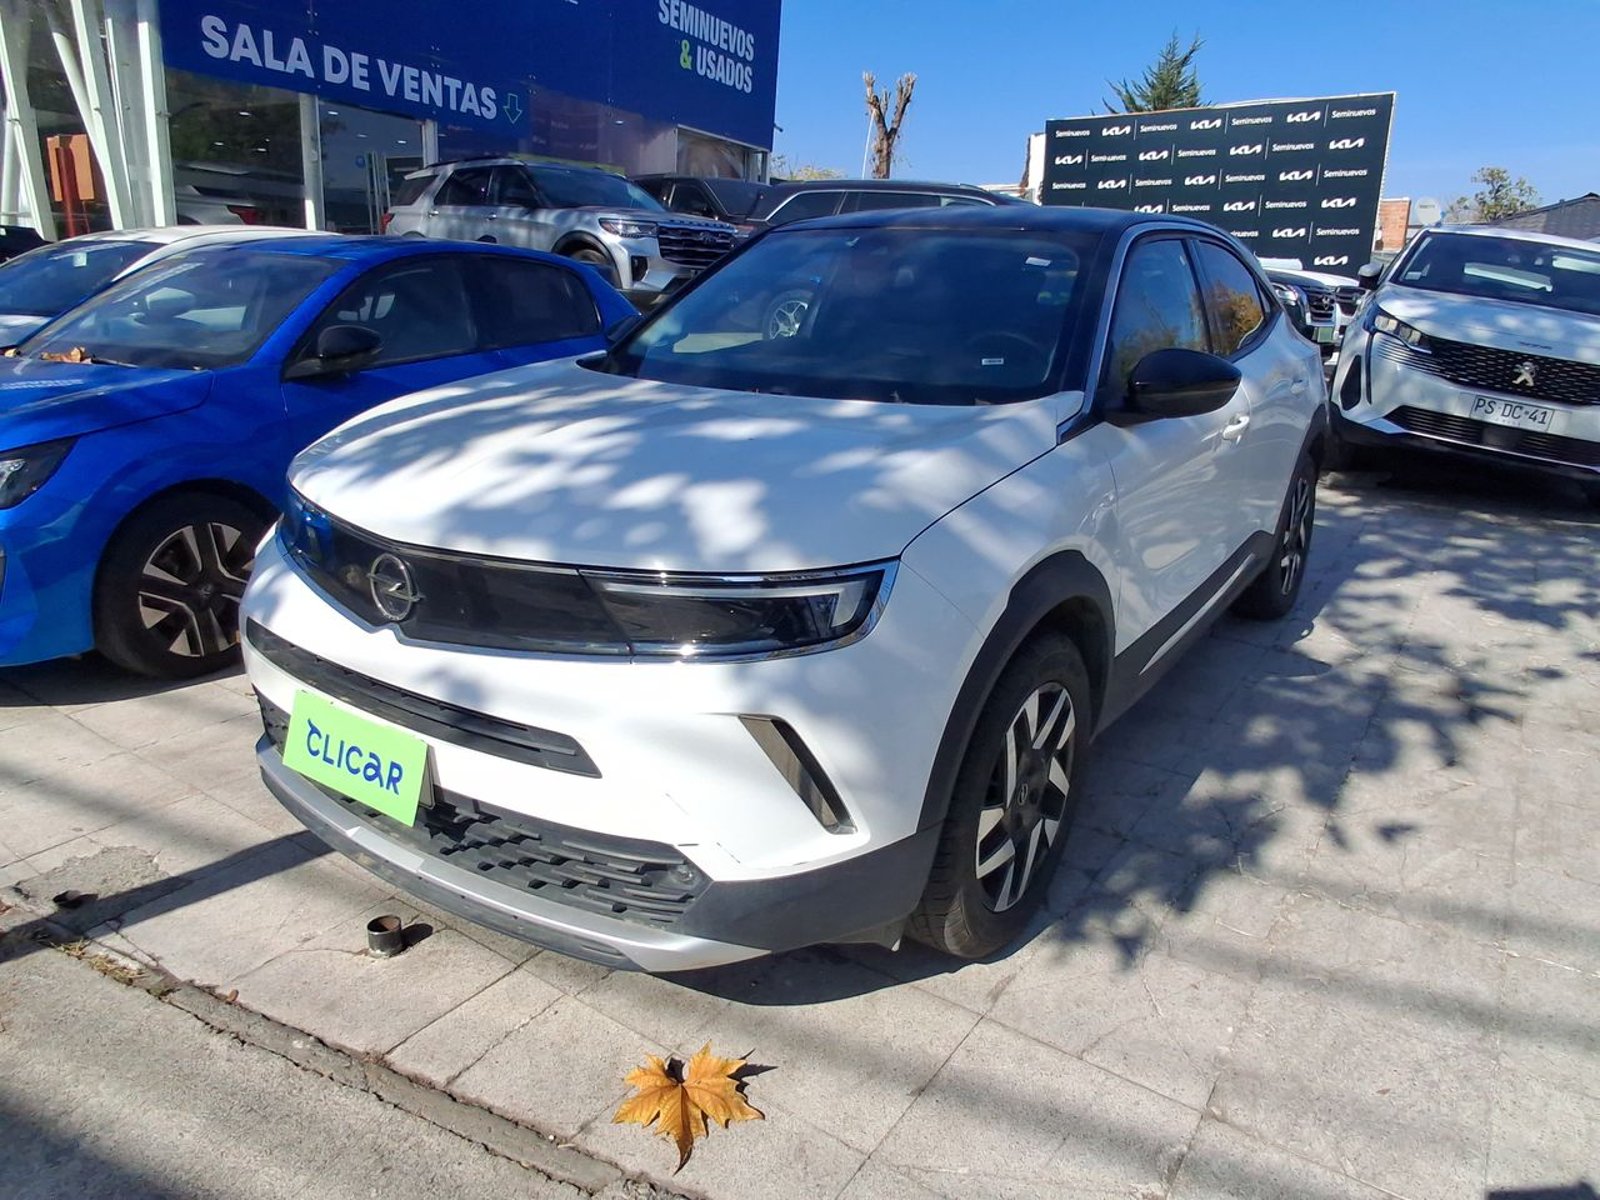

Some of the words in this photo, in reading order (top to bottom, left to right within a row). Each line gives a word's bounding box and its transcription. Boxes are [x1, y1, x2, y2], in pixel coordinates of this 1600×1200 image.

[658, 0, 755, 62] SEMINUEVOS
[200, 15, 315, 79] SALA
[323, 45, 371, 92] DE
[377, 59, 498, 120] VENTAS
[679, 39, 693, 70] &
[696, 47, 753, 94] USADOS
[1331, 108, 1377, 118] Seminuevos
[1231, 115, 1273, 126] Seminuevos
[1139, 123, 1178, 132] Seminuevos
[1055, 128, 1091, 138] Seminuevos
[1272, 142, 1315, 151] Seminuevos
[1177, 148, 1217, 157] Seminuevos
[1090, 153, 1127, 162] Seminuevos
[1224, 173, 1266, 182] Seminuevos
[1323, 169, 1368, 178] Seminuevos
[1051, 181, 1087, 190] Seminuevos
[1134, 178, 1173, 187] Seminuevos
[1171, 203, 1211, 212] Seminuevos
[1264, 200, 1308, 209] Seminuevos
[1315, 226, 1360, 236] Seminuevos
[1474, 398, 1497, 415] PS
